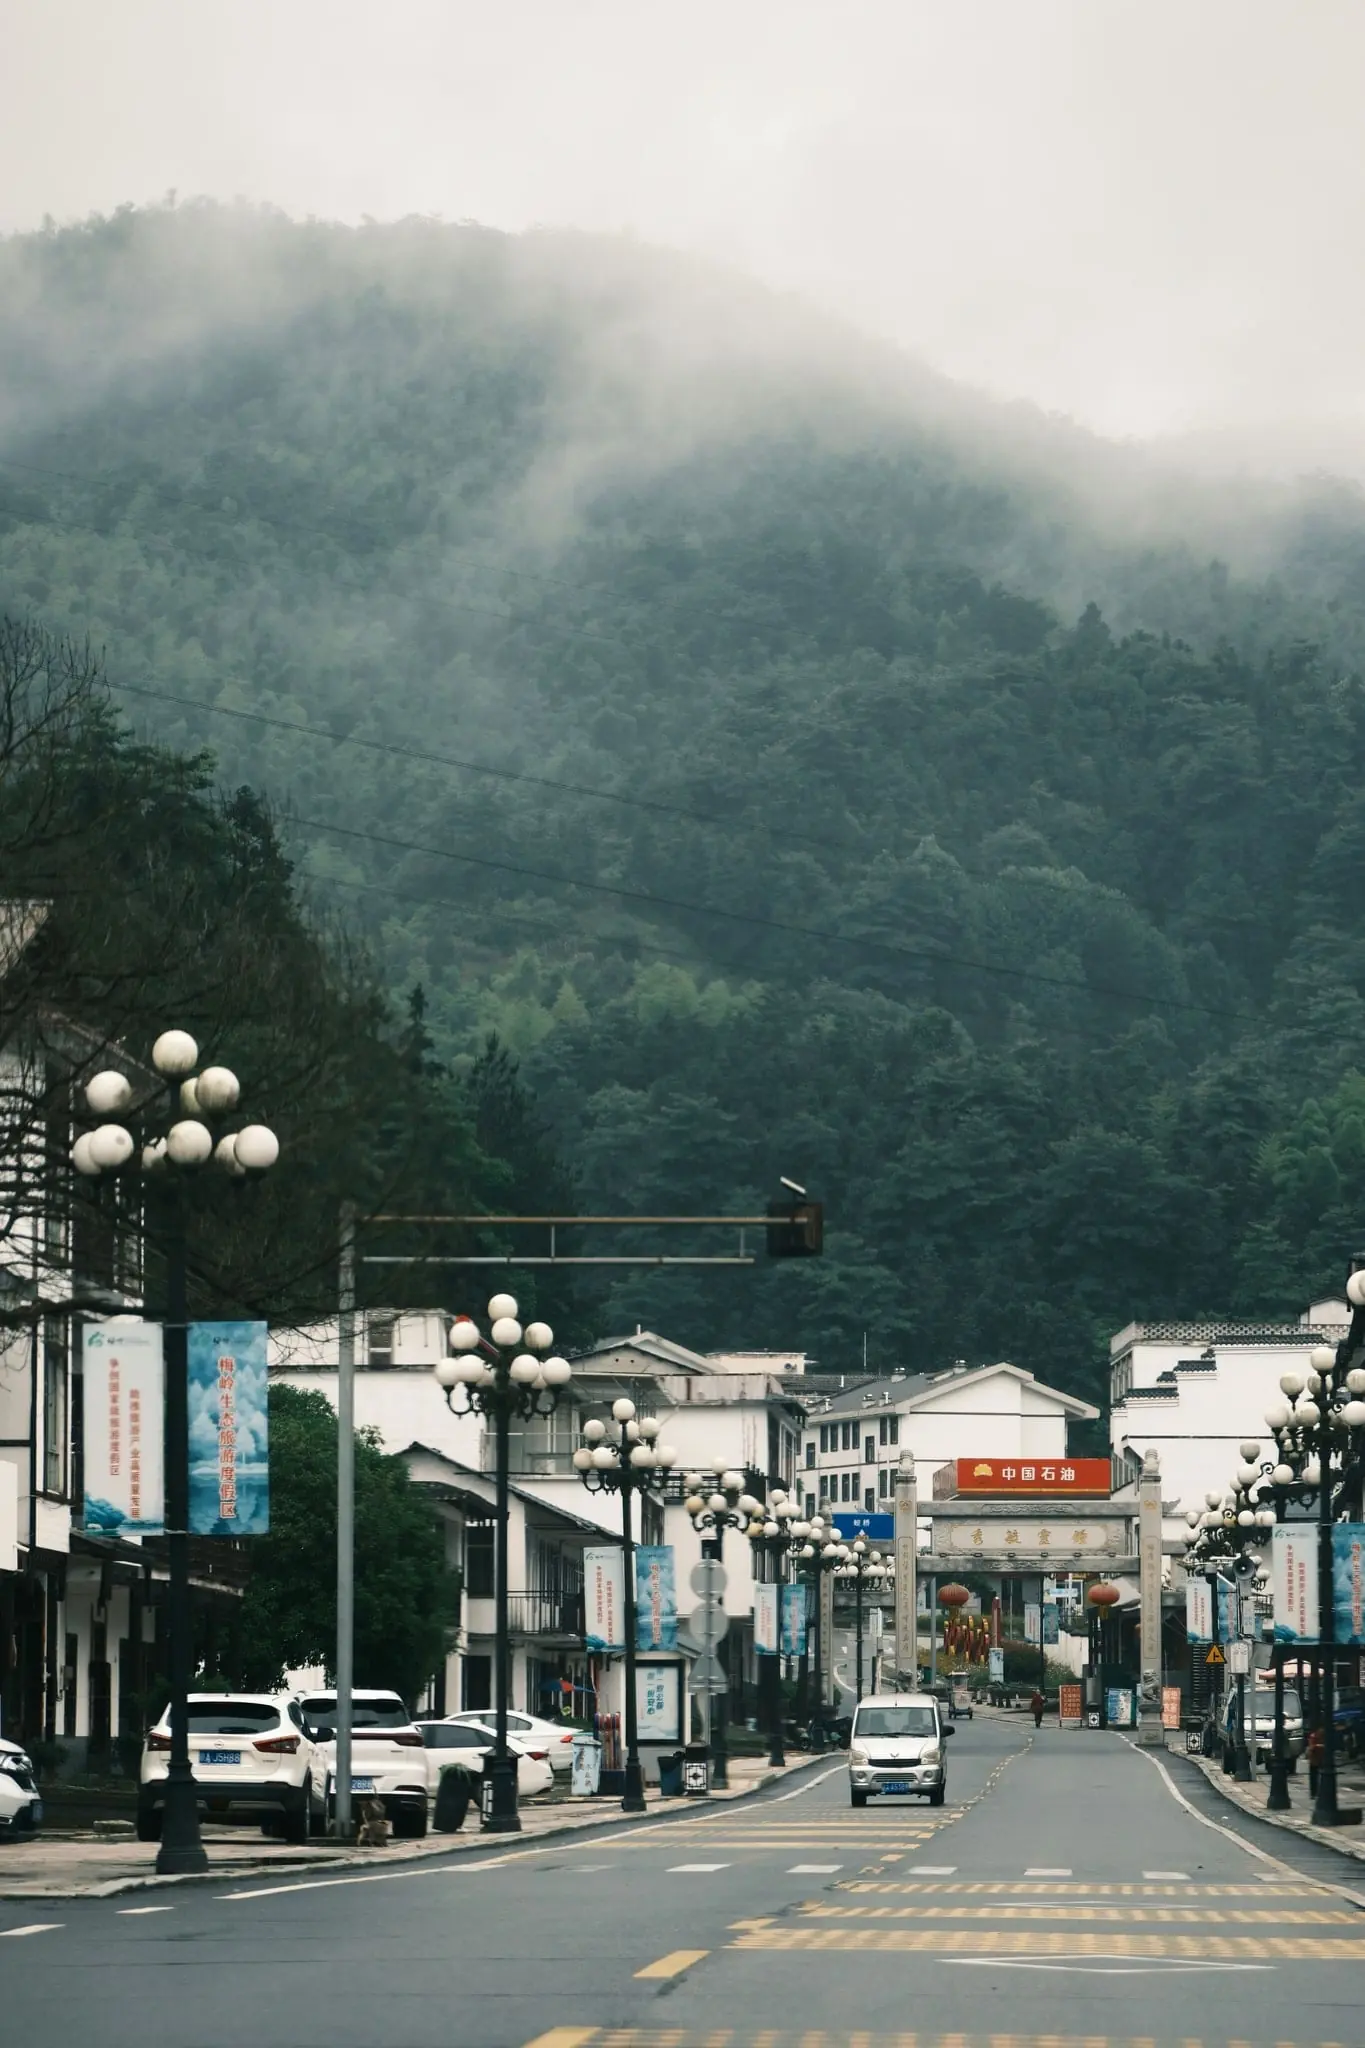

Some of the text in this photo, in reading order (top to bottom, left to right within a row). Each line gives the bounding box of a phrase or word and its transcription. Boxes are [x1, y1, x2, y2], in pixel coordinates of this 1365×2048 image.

[218, 1357, 236, 1518] 梅岭生态旅游度假区
[1002, 1467, 1075, 1481] 中国石油
